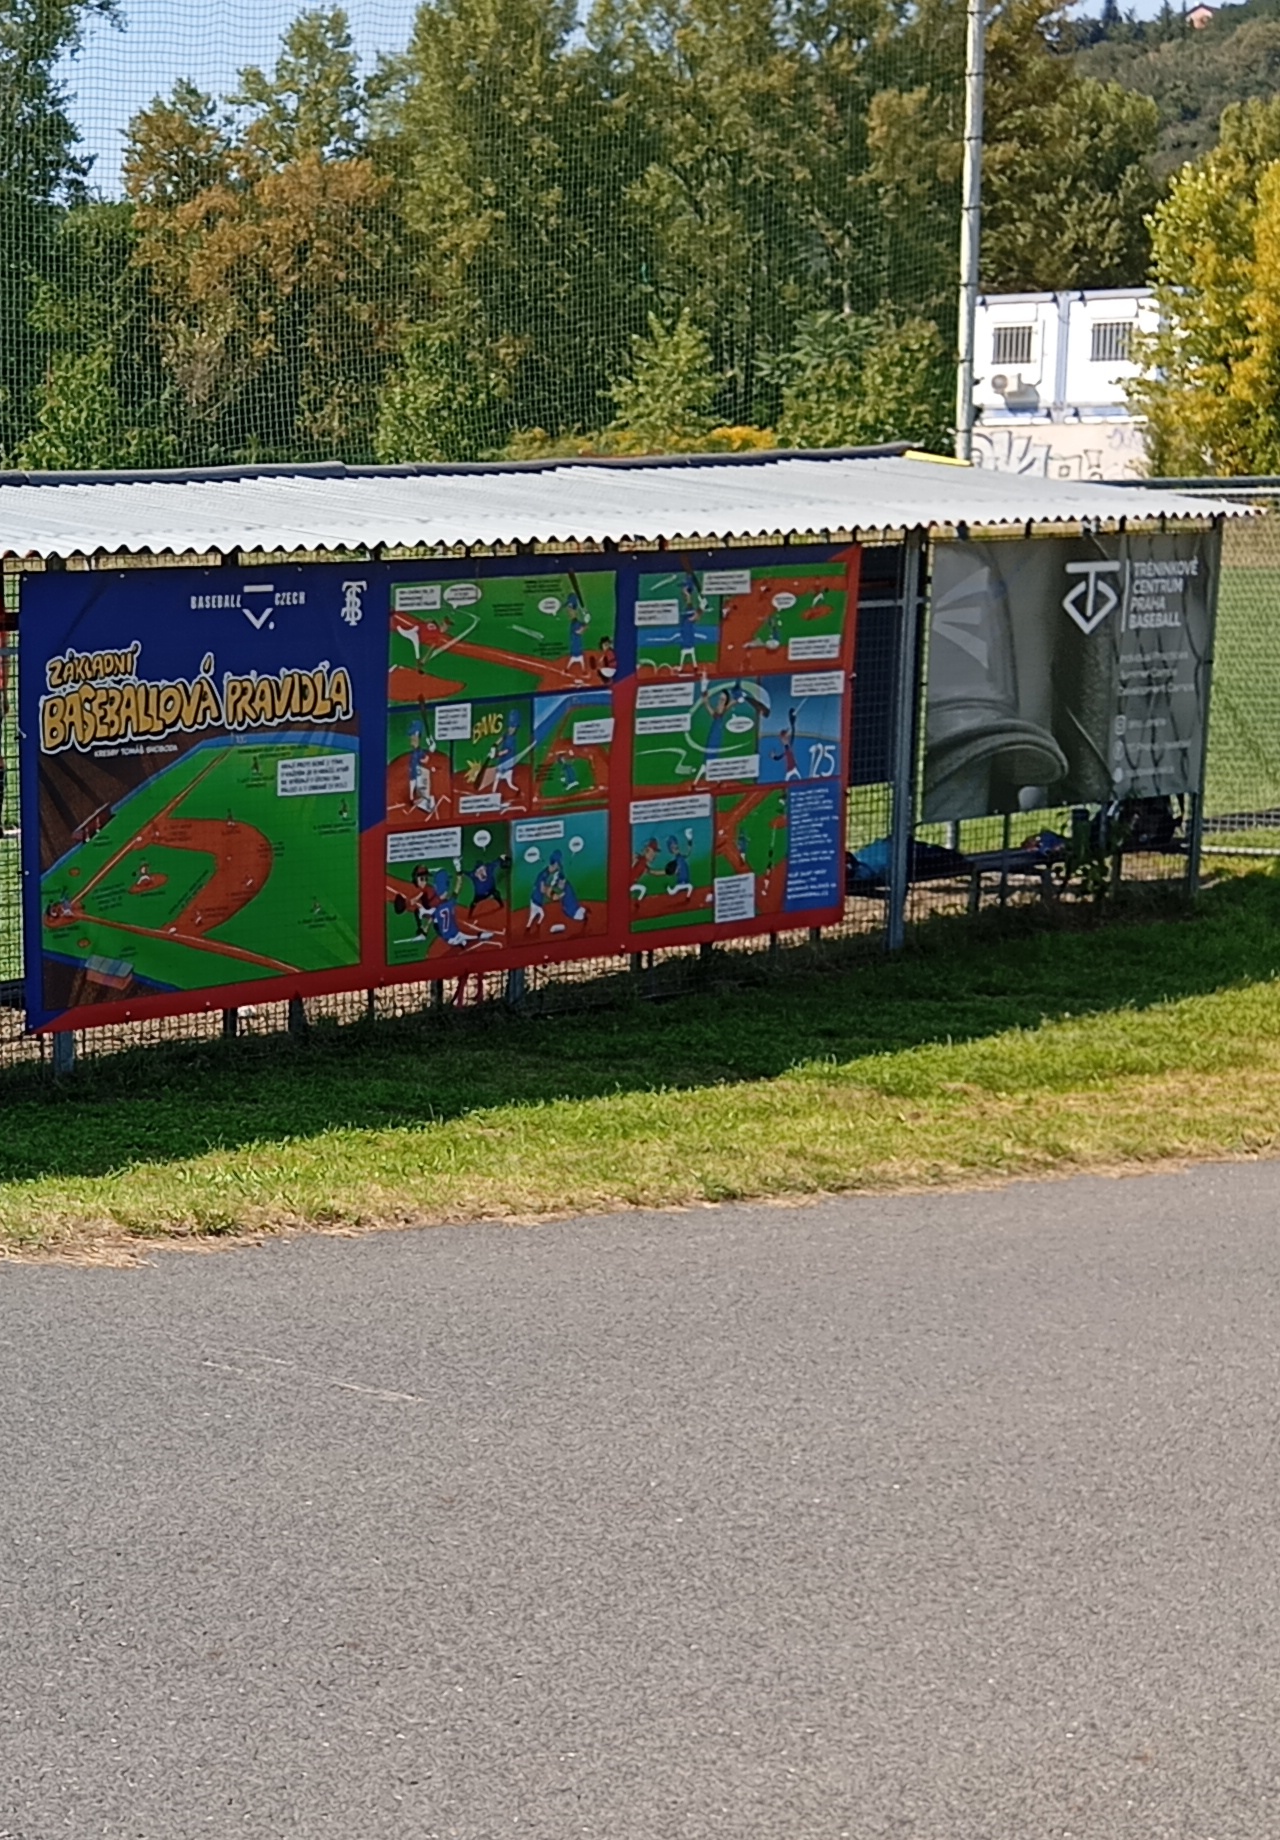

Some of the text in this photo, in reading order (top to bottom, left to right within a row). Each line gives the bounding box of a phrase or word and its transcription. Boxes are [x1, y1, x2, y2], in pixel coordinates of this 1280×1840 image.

[1133, 577, 1184, 595] CENTRUM
[190, 591, 306, 610] BASEBALL CZECH
[1130, 595, 1166, 612] PRAHA
[1128, 611, 1182, 630] BASEBALL
[47, 641, 140, 689] ZÁKLADNÍ
[40, 653, 352, 754] BASEBALLOVÁ PRAVIDLA
